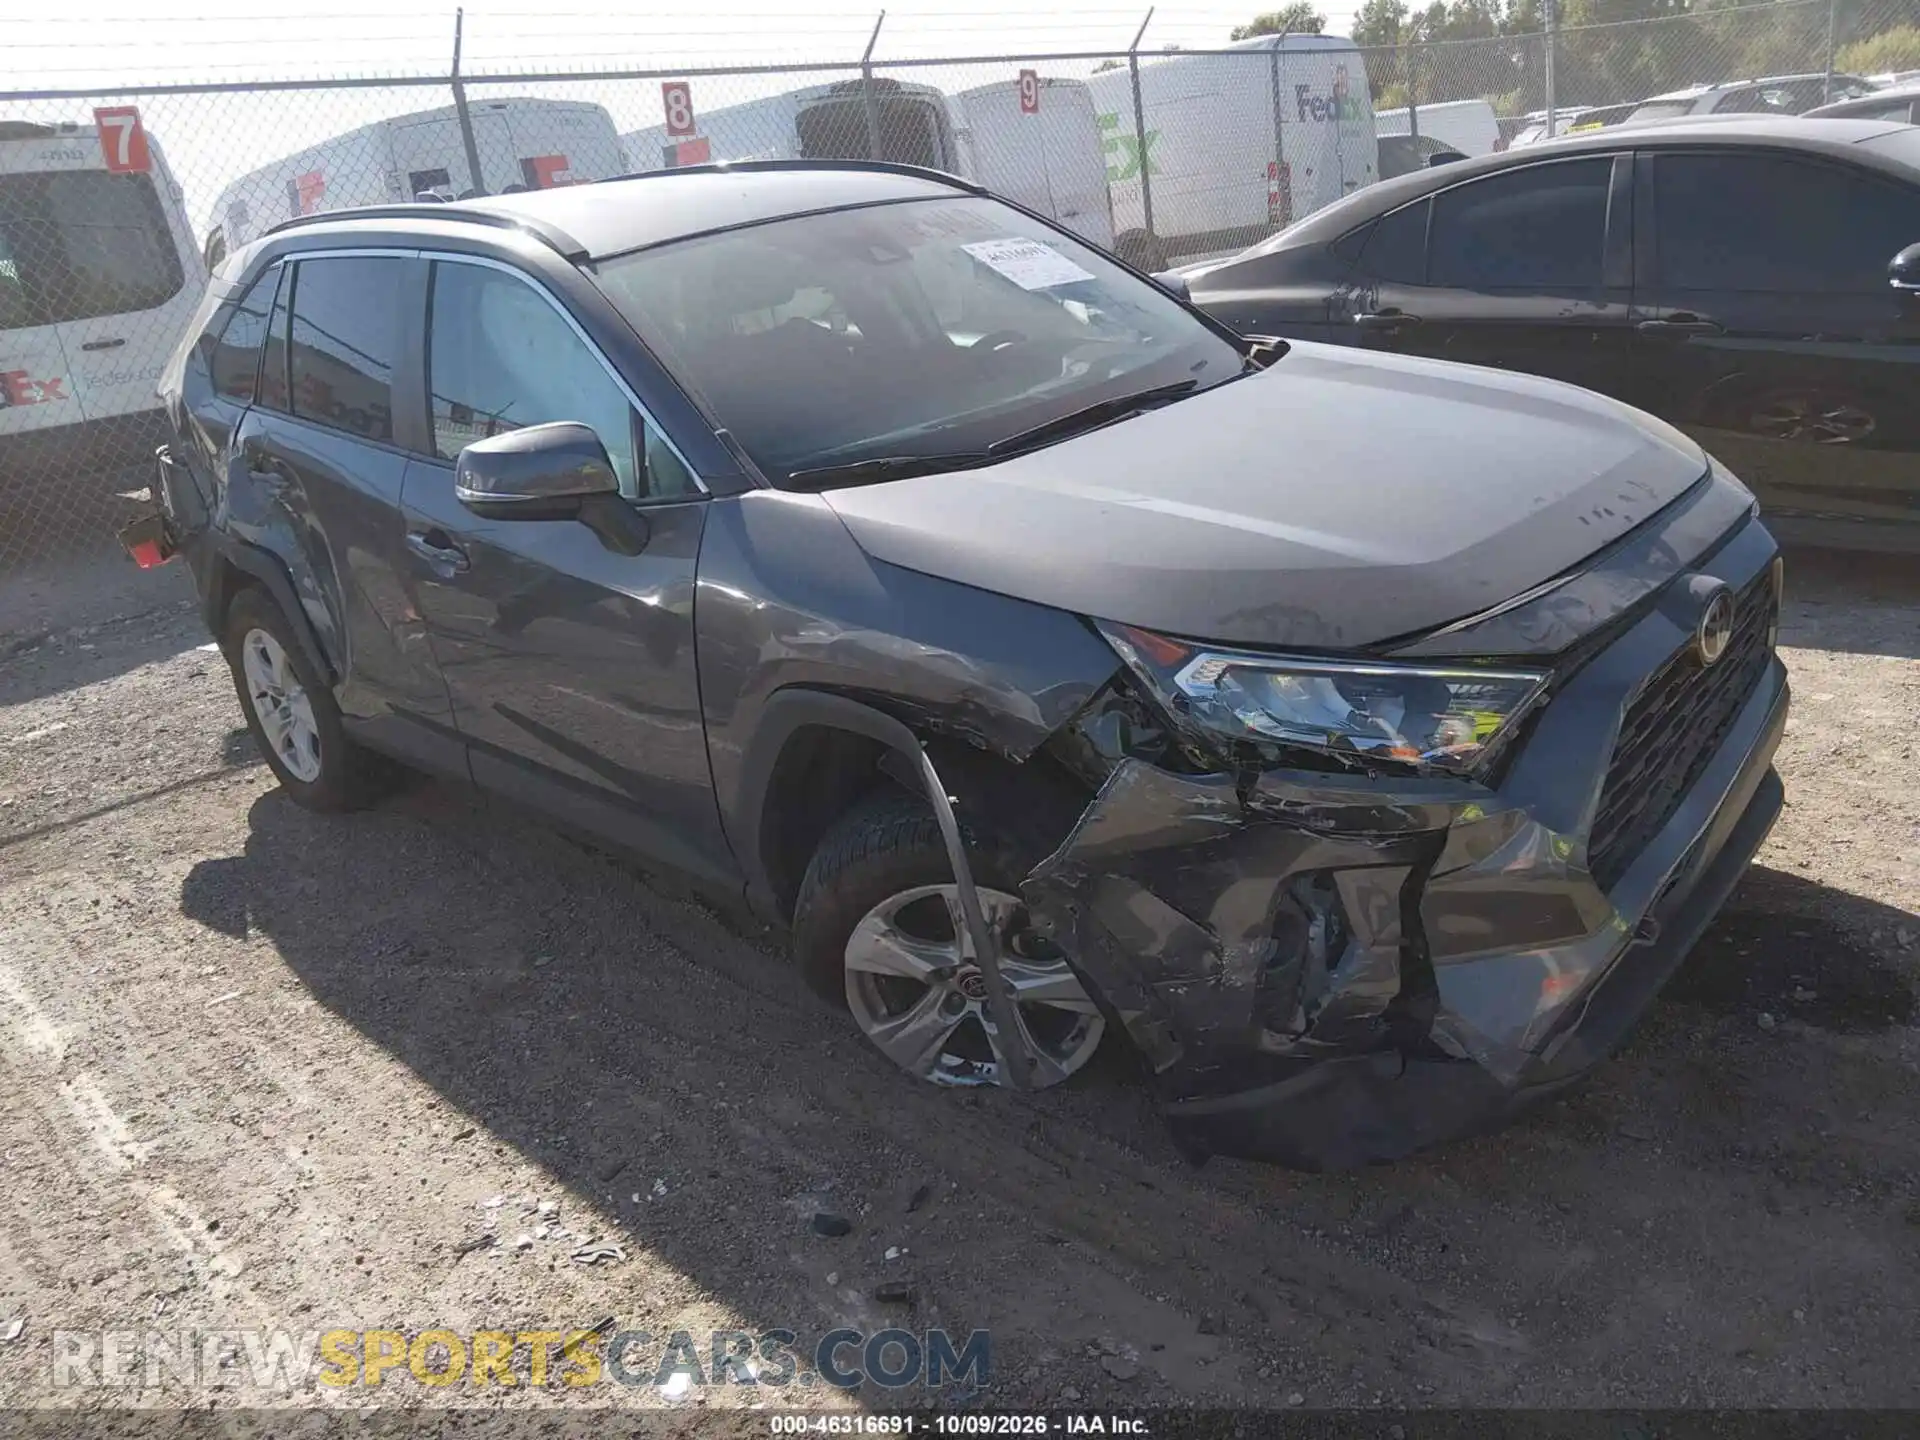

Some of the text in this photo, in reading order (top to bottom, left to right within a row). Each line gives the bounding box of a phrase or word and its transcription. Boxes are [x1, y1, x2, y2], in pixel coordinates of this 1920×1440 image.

[667, 88, 691, 129] 8
[1022, 75, 1036, 108] 9
[102, 115, 135, 164] 7
